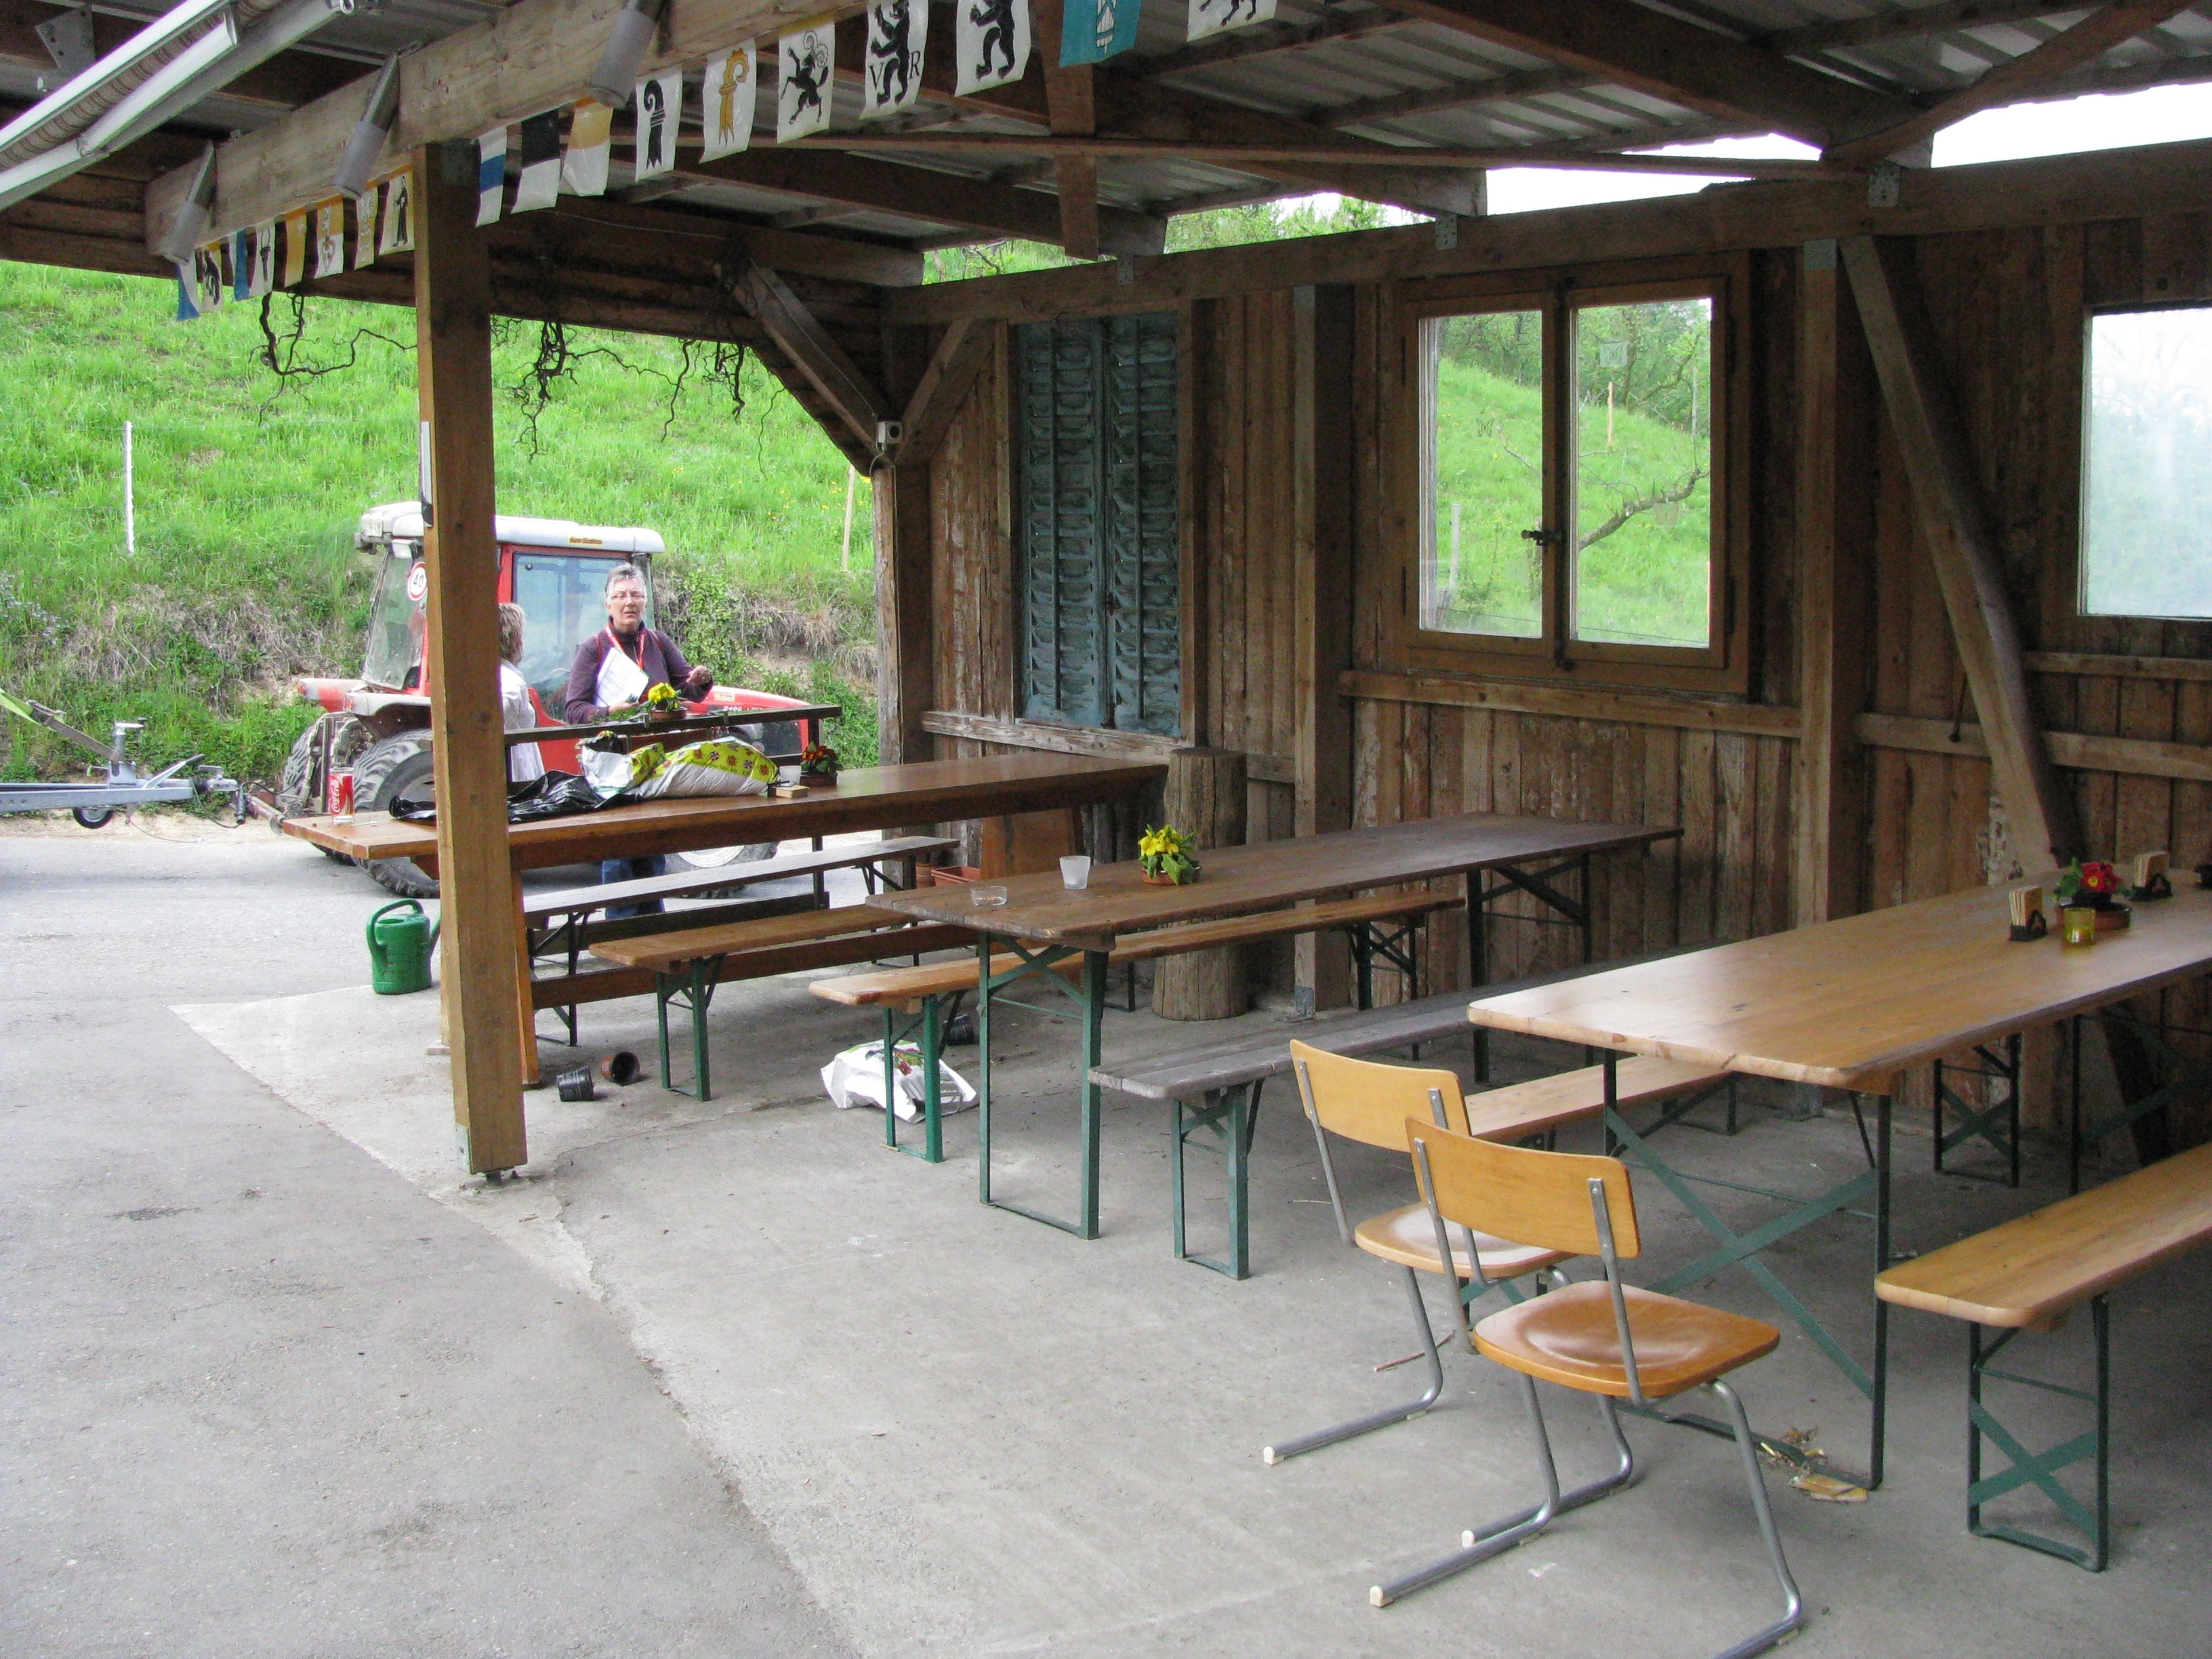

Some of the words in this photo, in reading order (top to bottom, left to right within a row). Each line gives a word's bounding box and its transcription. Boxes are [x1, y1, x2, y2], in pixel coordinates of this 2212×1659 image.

[869, 62, 884, 91] V
[908, 50, 921, 80] R
[413, 573, 424, 588] 40
